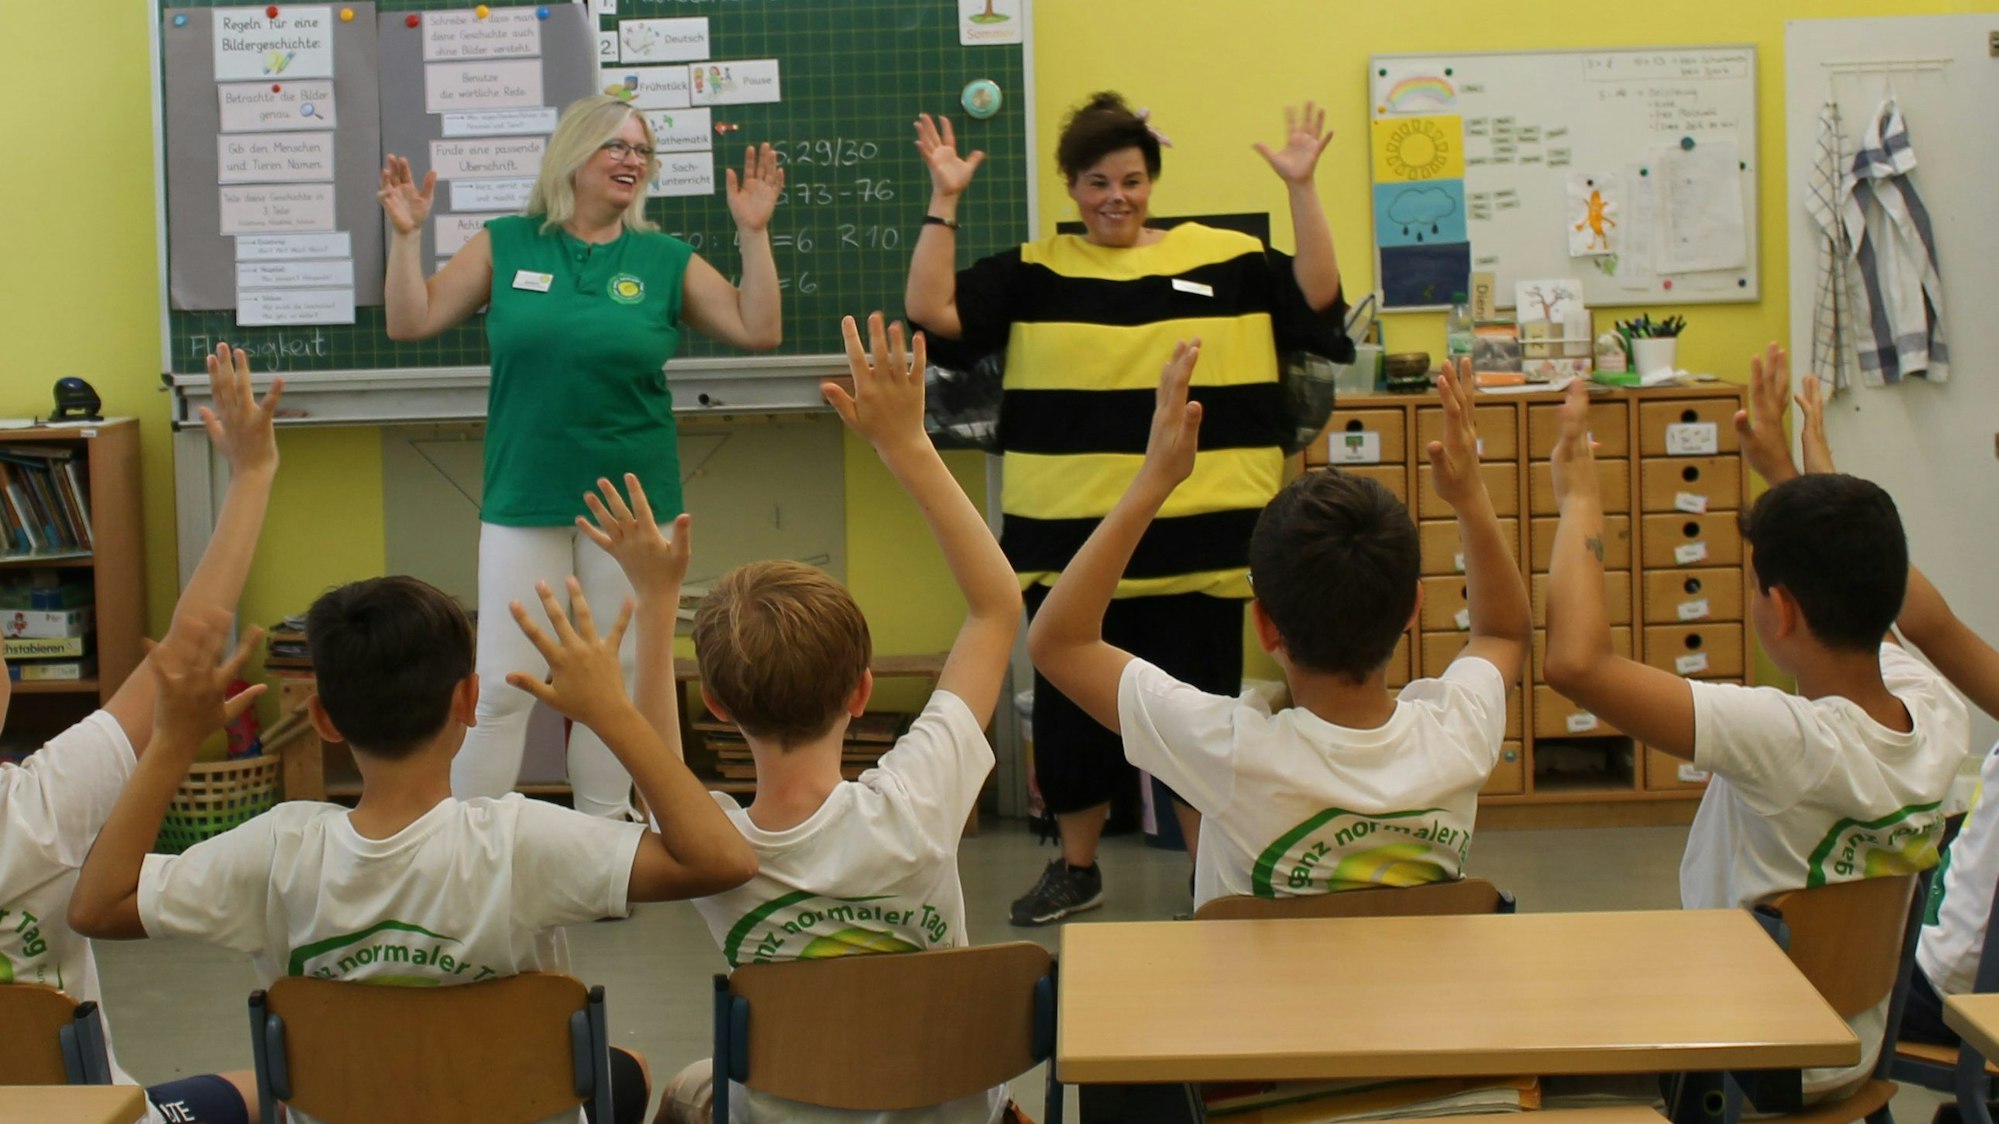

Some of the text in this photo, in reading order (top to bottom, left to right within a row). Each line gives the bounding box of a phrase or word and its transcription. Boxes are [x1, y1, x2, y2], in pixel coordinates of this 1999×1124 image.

[223, 17, 262, 34] Regeln
[294, 19, 319, 29] eine
[665, 34, 705, 43] Deutsch
[600, 40, 616, 55] 2.
[639, 81, 688, 91] Frühstück
[743, 76, 772, 85] Pause
[225, 89, 328, 104] Betrachte die Bilder
[249, 142, 268, 154] den
[274, 141, 322, 153] Menschen
[436, 142, 540, 156] Finde eine passende
[227, 160, 246, 171] und
[253, 159, 282, 170] Tieren
[672, 162, 699, 172] Sach-
[662, 176, 711, 185] unterricht
[1288, 840, 1331, 889] ganz
[1334, 819, 1459, 848] normaler
[780, 904, 914, 936] normaler
[919, 904, 948, 943] Tag
[14, 910, 48, 958] Tag
[337, 943, 472, 978] normaler
